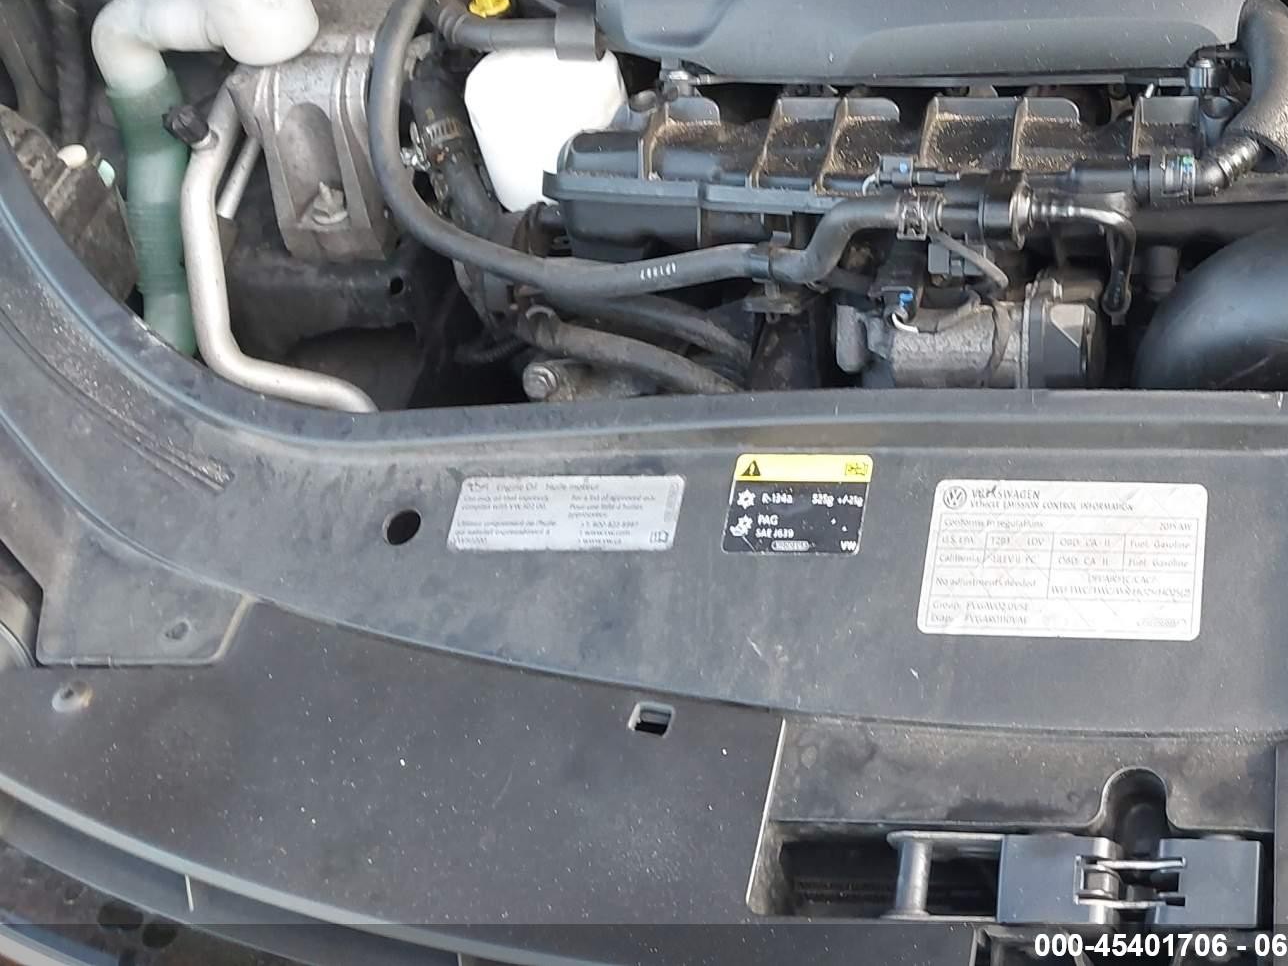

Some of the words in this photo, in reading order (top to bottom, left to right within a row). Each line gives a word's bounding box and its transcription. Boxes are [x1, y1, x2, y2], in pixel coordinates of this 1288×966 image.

[761, 492, 793, 504] R-134a
[1003, 500, 1039, 510] EMISSION
[1042, 501, 1076, 510] CONTROL
[1080, 502, 1134, 512] INFORMATION
[757, 513, 779, 525] PAG
[755, 528, 772, 538] SAE
[840, 540, 857, 551] VW
[1153, 539, 1190, 549] Gasoline
[1152, 558, 1189, 568] Gasoline
